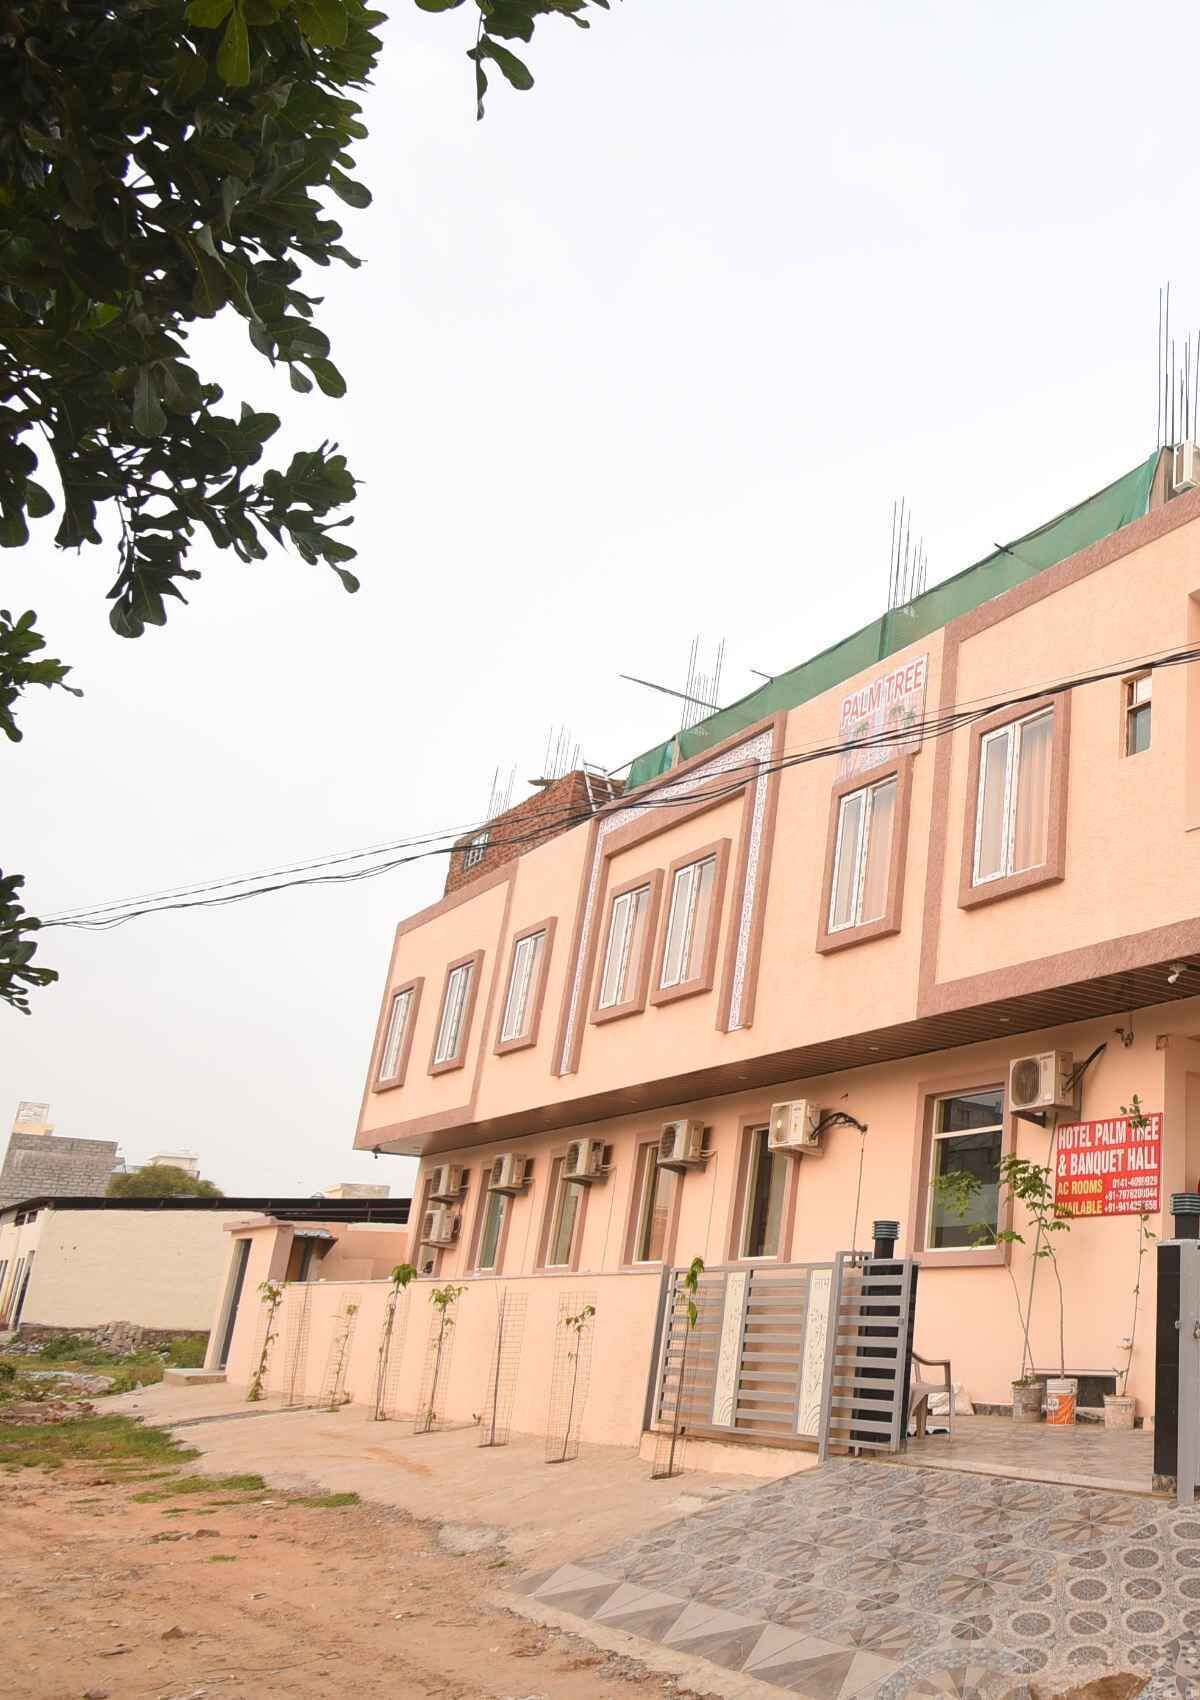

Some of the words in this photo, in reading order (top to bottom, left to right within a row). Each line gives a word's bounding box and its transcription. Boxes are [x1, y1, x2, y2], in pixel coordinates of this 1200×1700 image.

[842, 680, 882, 719] PALM
[886, 660, 924, 702] TREE
[1058, 1125, 1092, 1150] HOTEL
[1095, 1120, 1127, 1146] PALM
[1058, 1153, 1067, 1176] &
[1070, 1148, 1125, 1176] BANQUET
[1127, 1146, 1158, 1171] HALL
[1057, 1181, 1069, 1196] AC
[1071, 1179, 1103, 1195] ROOMS
